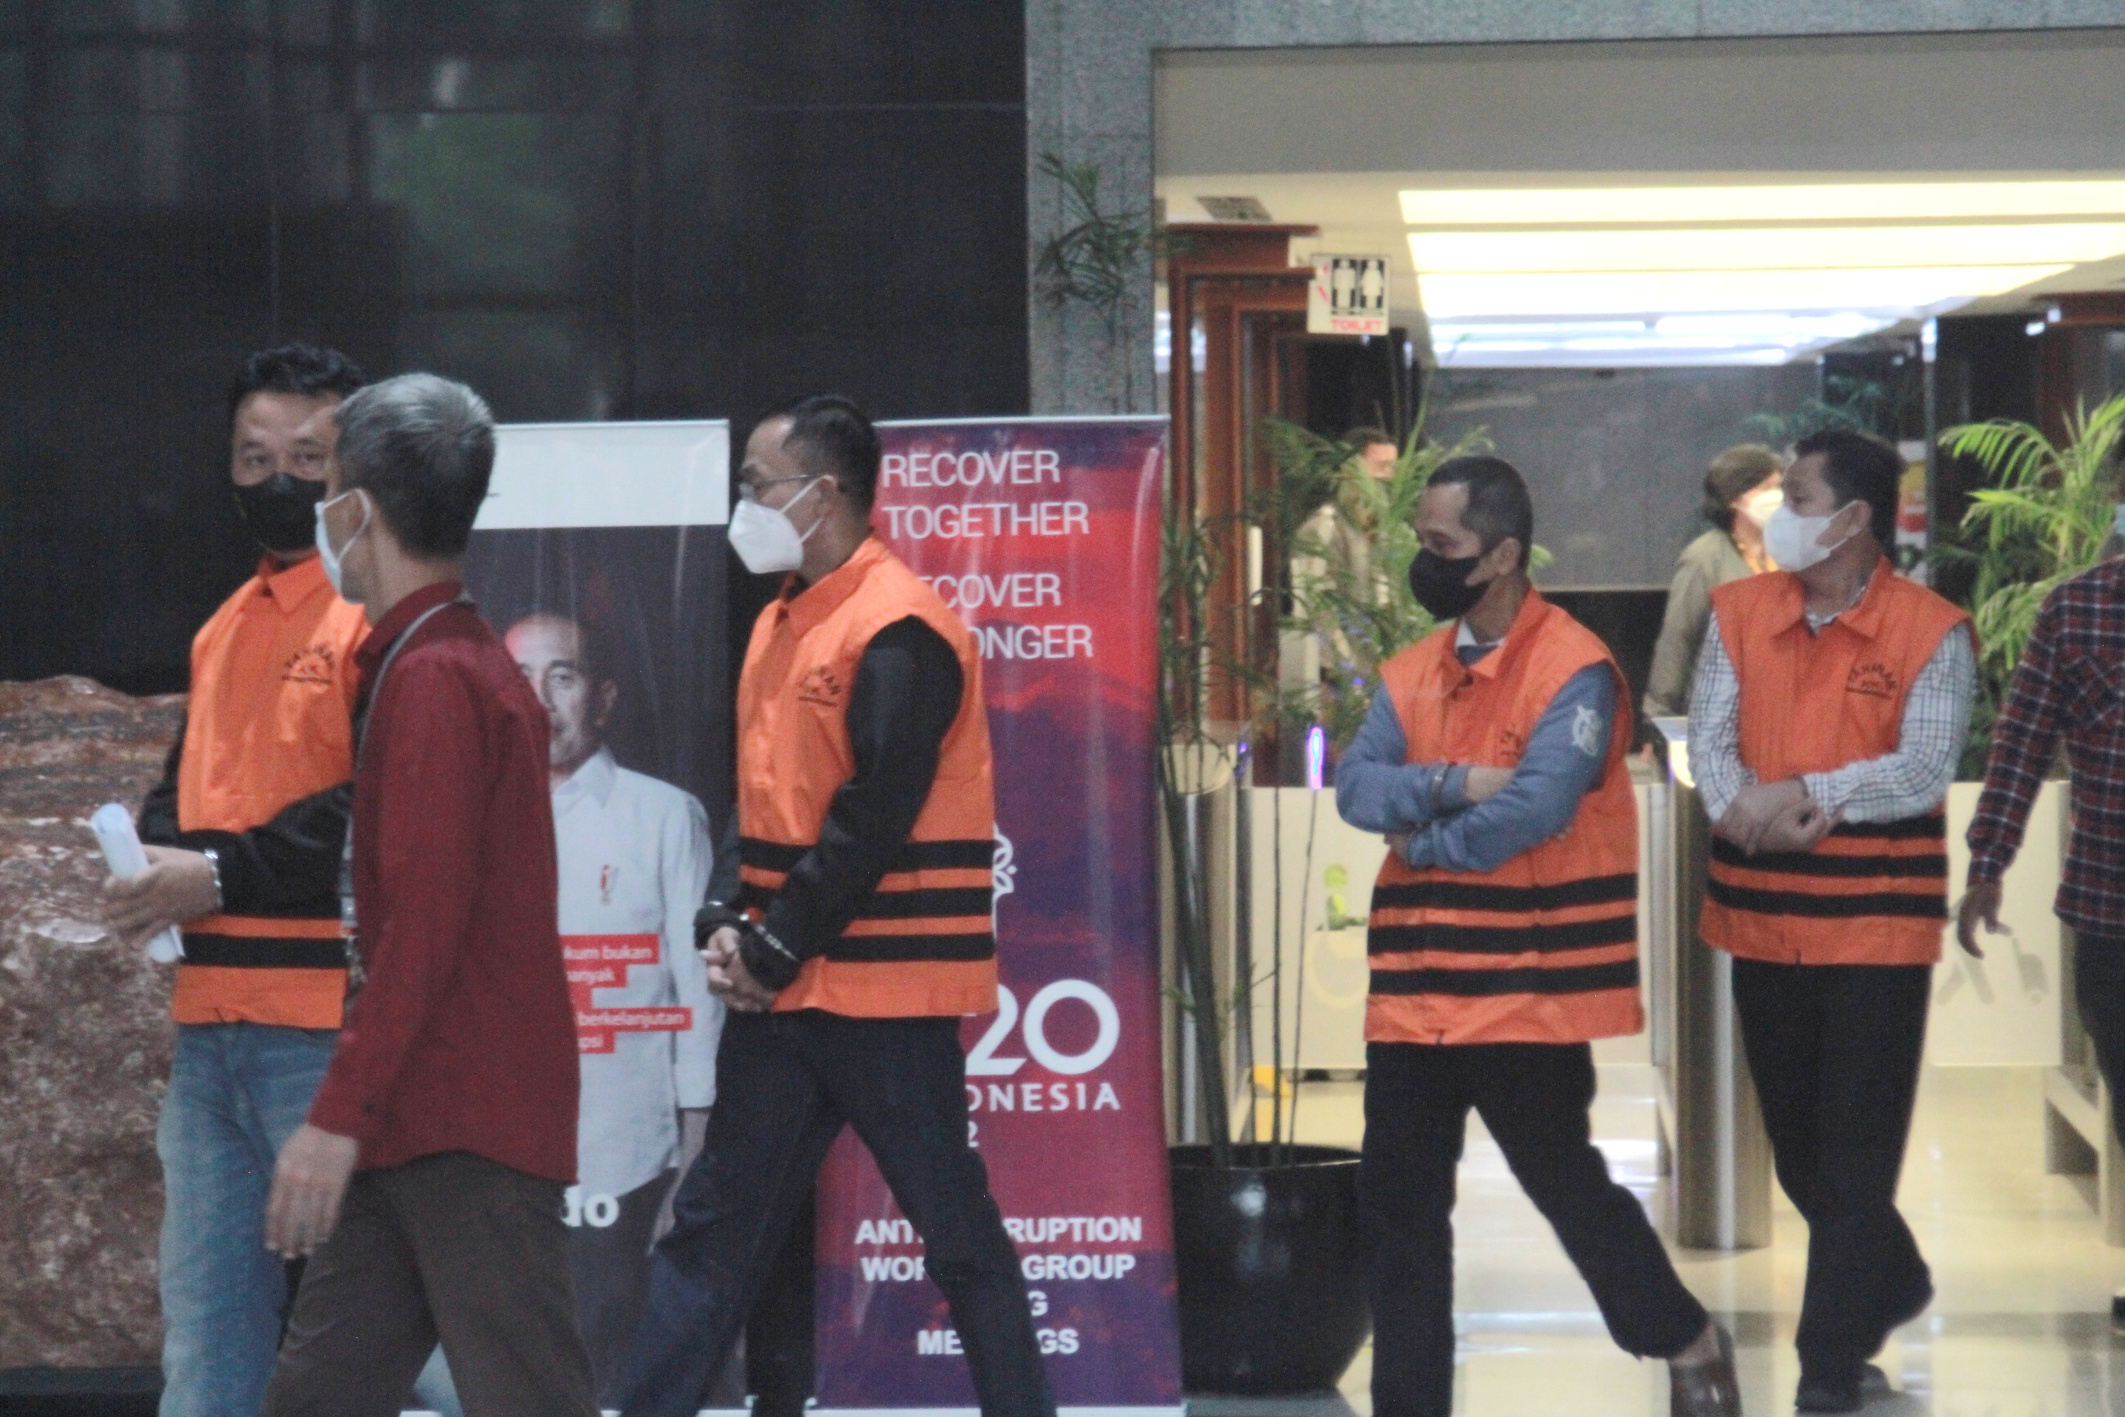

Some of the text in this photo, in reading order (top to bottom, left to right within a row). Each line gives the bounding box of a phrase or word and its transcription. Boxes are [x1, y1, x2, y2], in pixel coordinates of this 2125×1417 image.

[881, 450, 1060, 487] RECOVER
[881, 502, 1089, 539] TOGETHER
[919, 573, 1061, 609] COVER
[602, 945, 653, 960] bukan
[855, 1220, 924, 1244] ANT
[1021, 1254, 1136, 1280] GROUP
